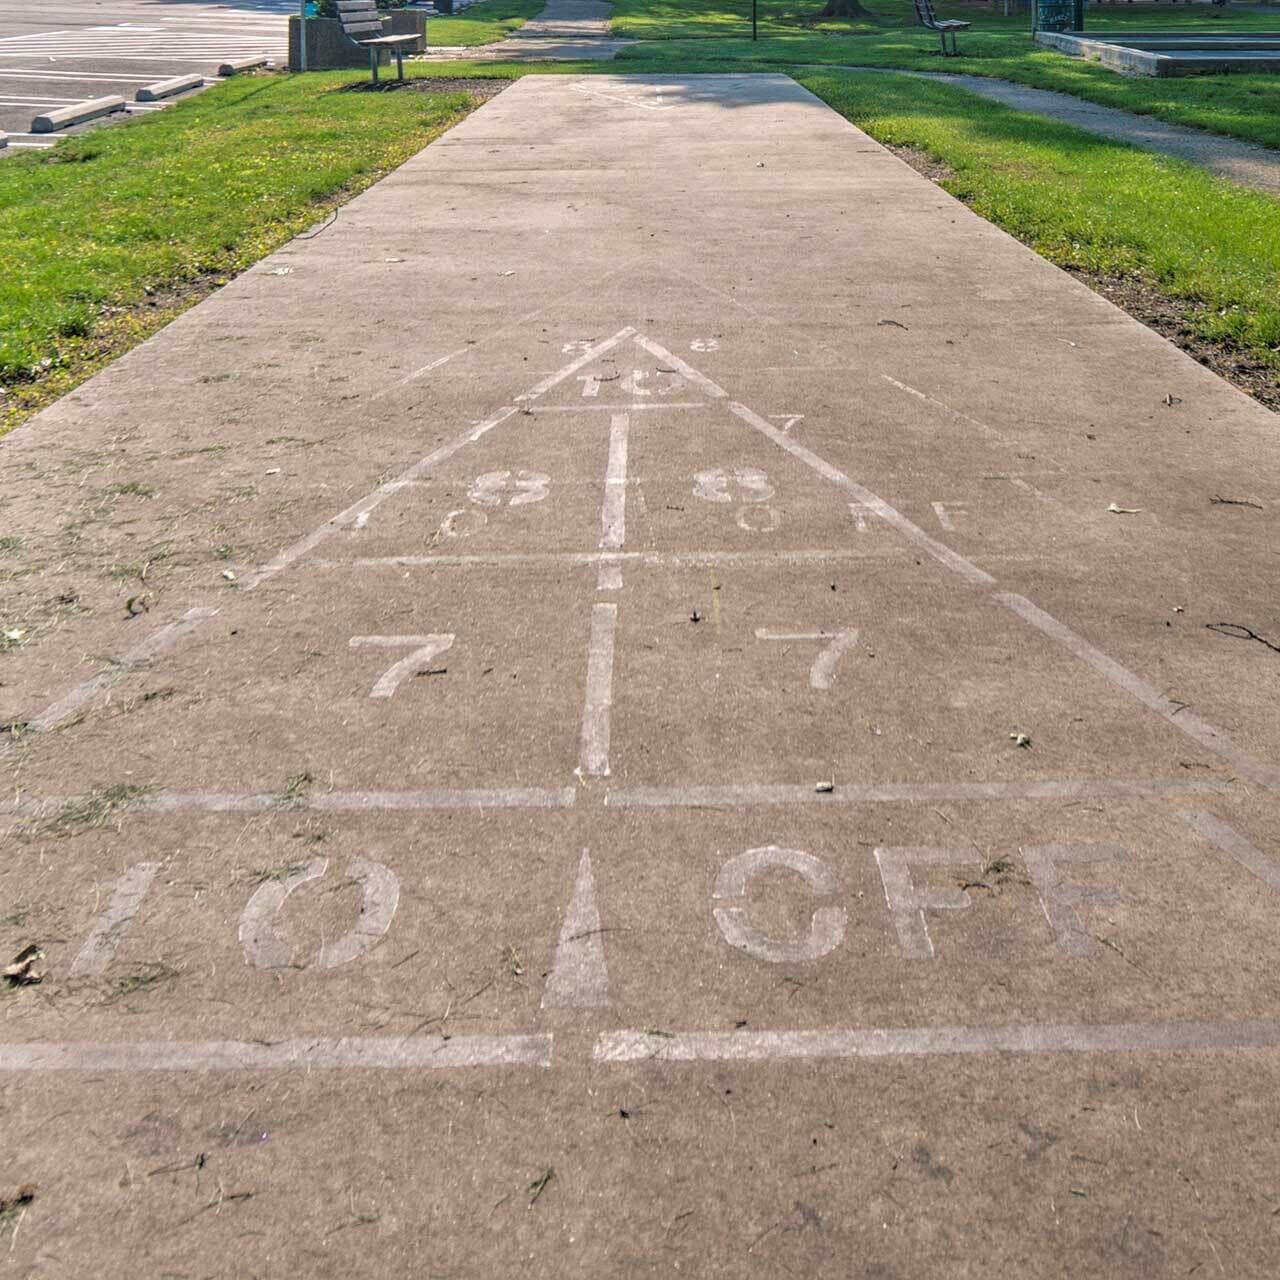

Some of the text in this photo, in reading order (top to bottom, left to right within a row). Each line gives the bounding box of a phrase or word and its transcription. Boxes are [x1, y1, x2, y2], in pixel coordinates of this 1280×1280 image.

[467, 469, 552, 506] 8
[692, 467, 776, 504] 8
[349, 633, 456, 698] 7
[755, 627, 859, 689] 7
[67, 854, 402, 977] 10
[712, 844, 1126, 963] OFF
